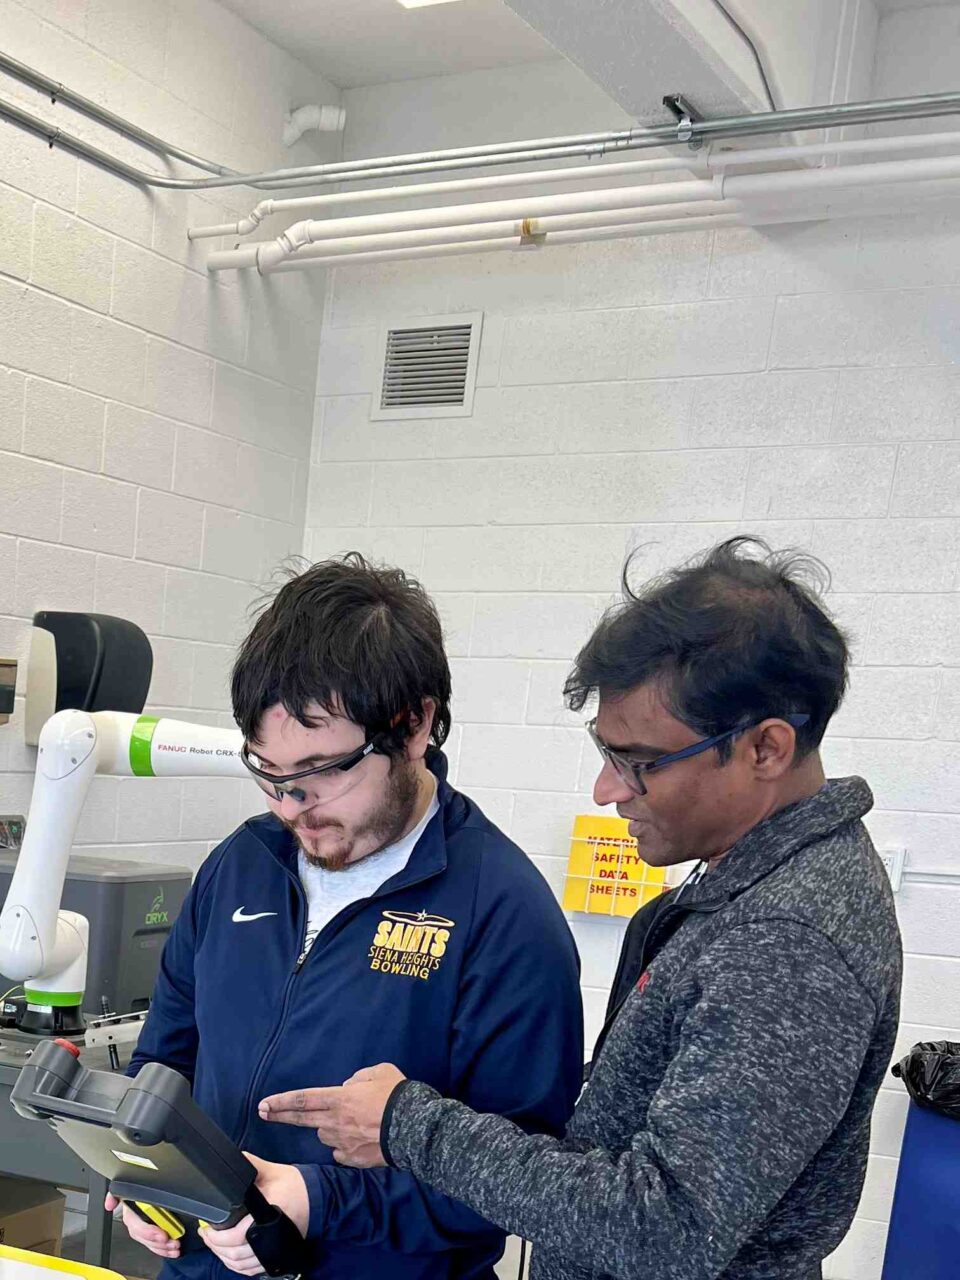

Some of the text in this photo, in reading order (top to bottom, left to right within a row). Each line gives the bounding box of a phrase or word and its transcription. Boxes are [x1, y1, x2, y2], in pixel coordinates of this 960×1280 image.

[158, 744, 187, 753] FANUC
[189, 747, 213, 755] Robot
[586, 835, 638, 849] MATERI
[594, 852, 641, 865] SAFETY
[598, 869, 628, 881] DATA
[589, 884, 637, 897] SHEETS
[145, 911, 168, 925] ORYX
[373, 920, 450, 957] SAINTS
[368, 945, 441, 970] SIENA HEIGHTS
[370, 958, 430, 980] BOWLING
